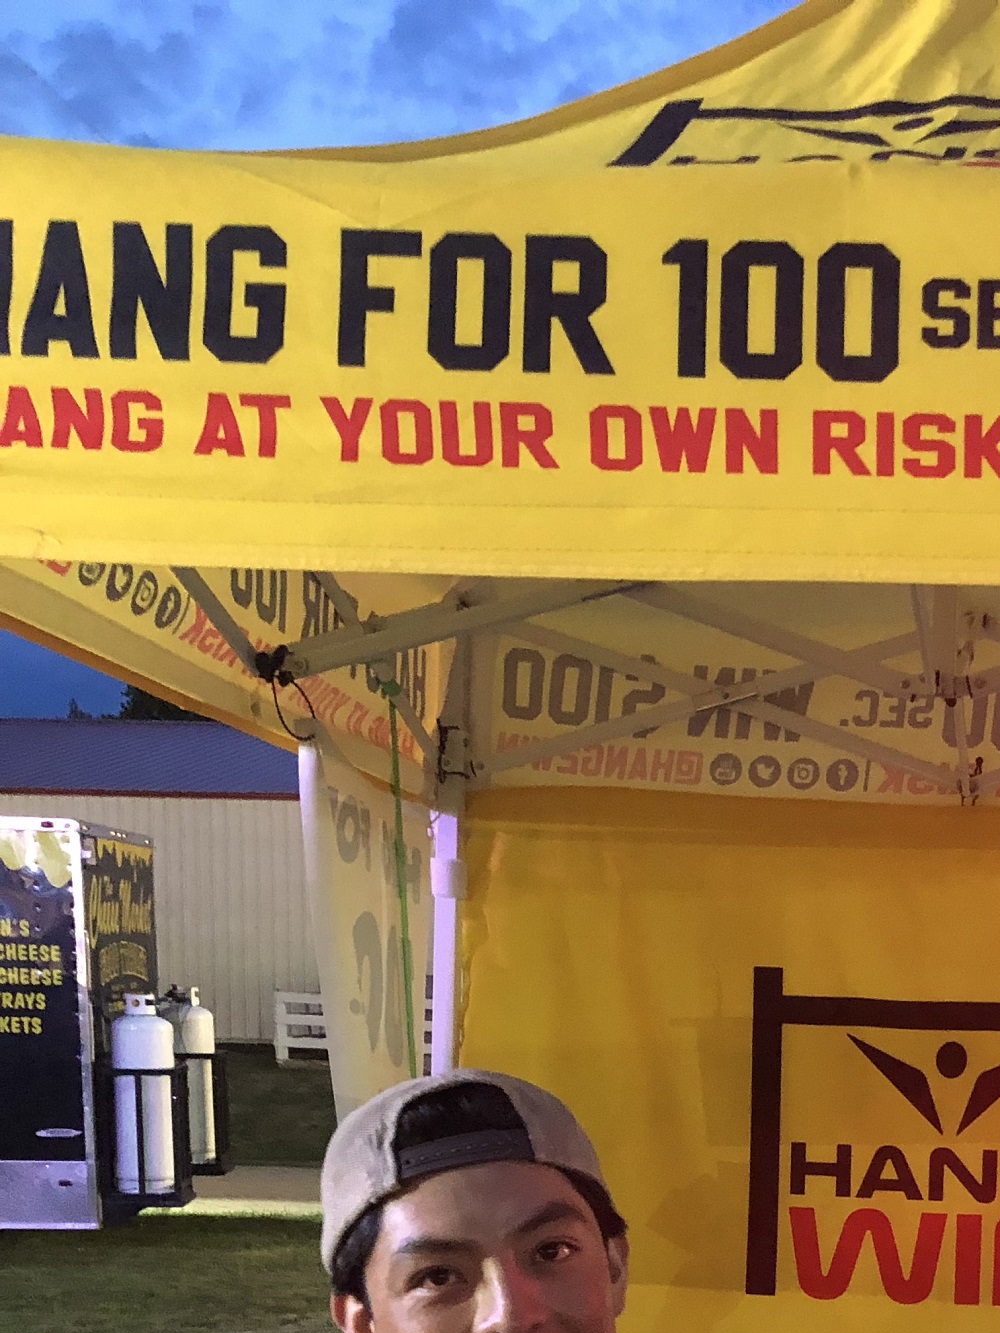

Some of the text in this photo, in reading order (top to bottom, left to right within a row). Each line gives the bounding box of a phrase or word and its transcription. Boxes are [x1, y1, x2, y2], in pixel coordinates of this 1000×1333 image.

[337, 228, 616, 376] FOR
[661, 238, 901, 383] 100
[0, 385, 165, 453] ANG
[194, 392, 291, 459] AT
[319, 396, 559, 469] YOUR
[588, 404, 779, 475] OWN
[0, 992, 46, 1010] RAYS
